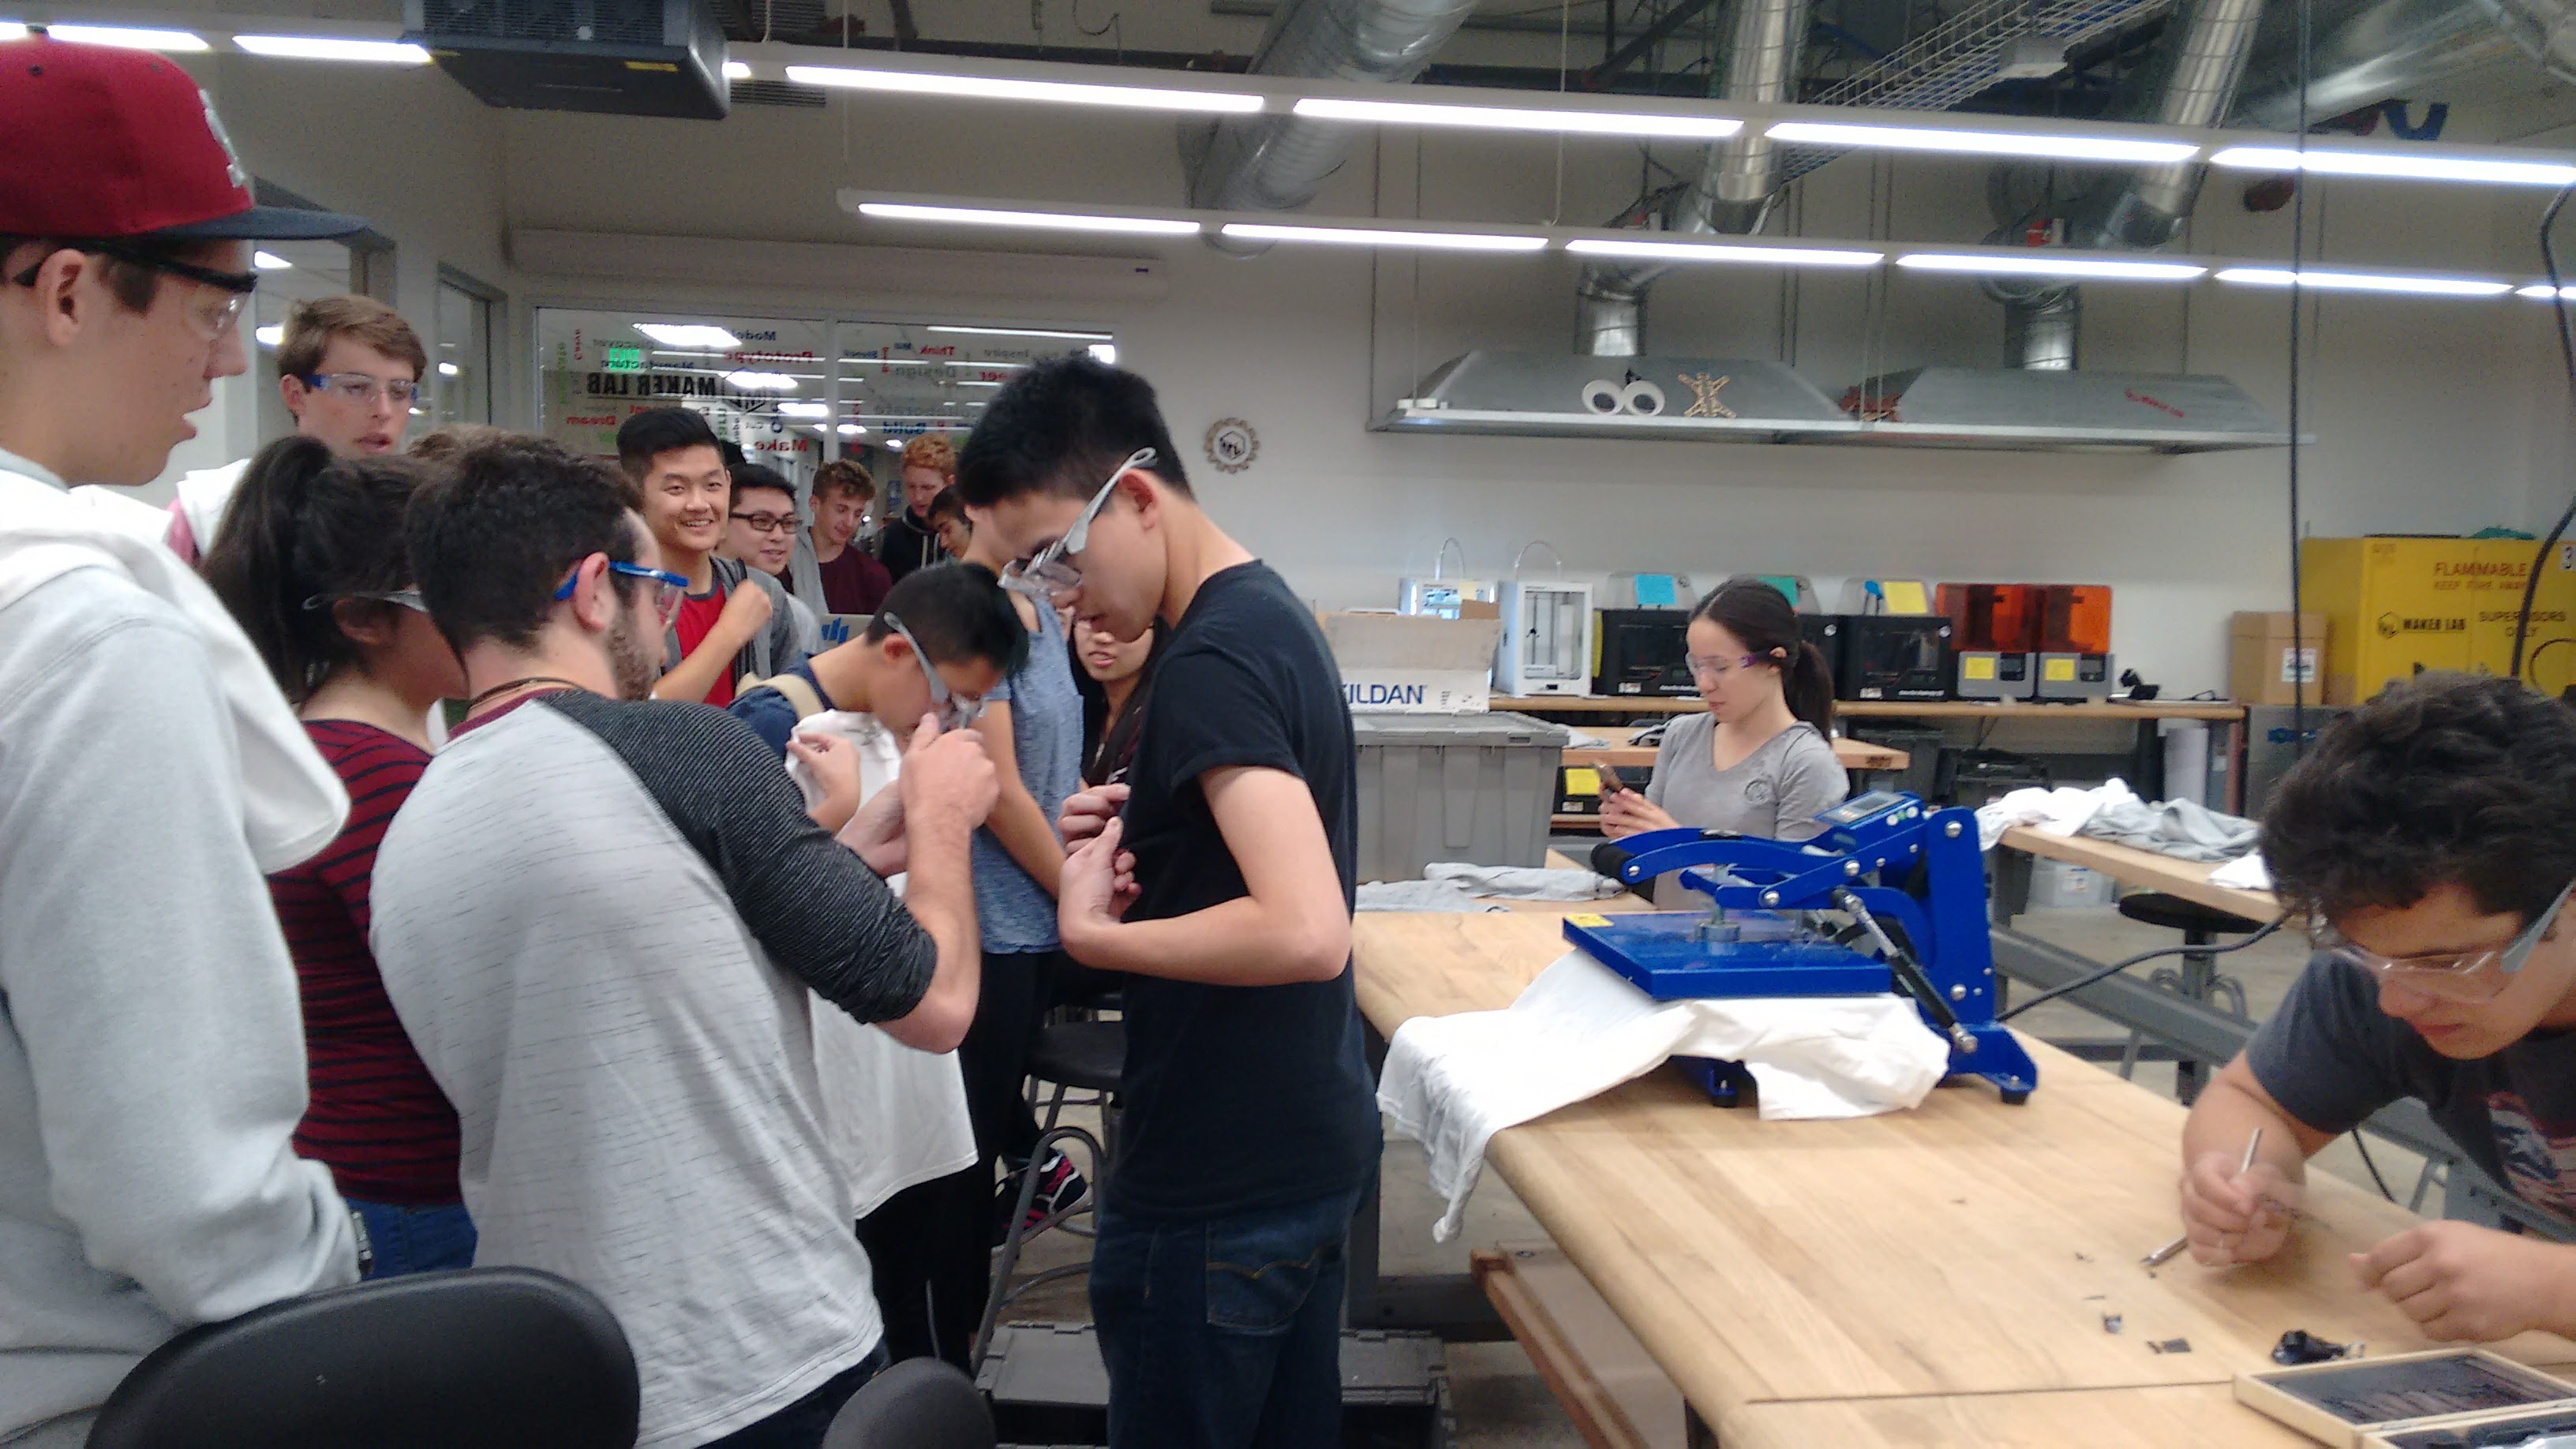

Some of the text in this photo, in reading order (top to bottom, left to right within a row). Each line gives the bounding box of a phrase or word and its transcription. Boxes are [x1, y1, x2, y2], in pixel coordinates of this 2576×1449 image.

[2434, 562, 2528, 577] FLAMMABLE
[2478, 611, 2567, 623] SUPERSORS
[2403, 619, 2466, 631] MAKER LAB
[2506, 625, 2539, 638] OLY
[1343, 683, 1424, 705] ILDAN
